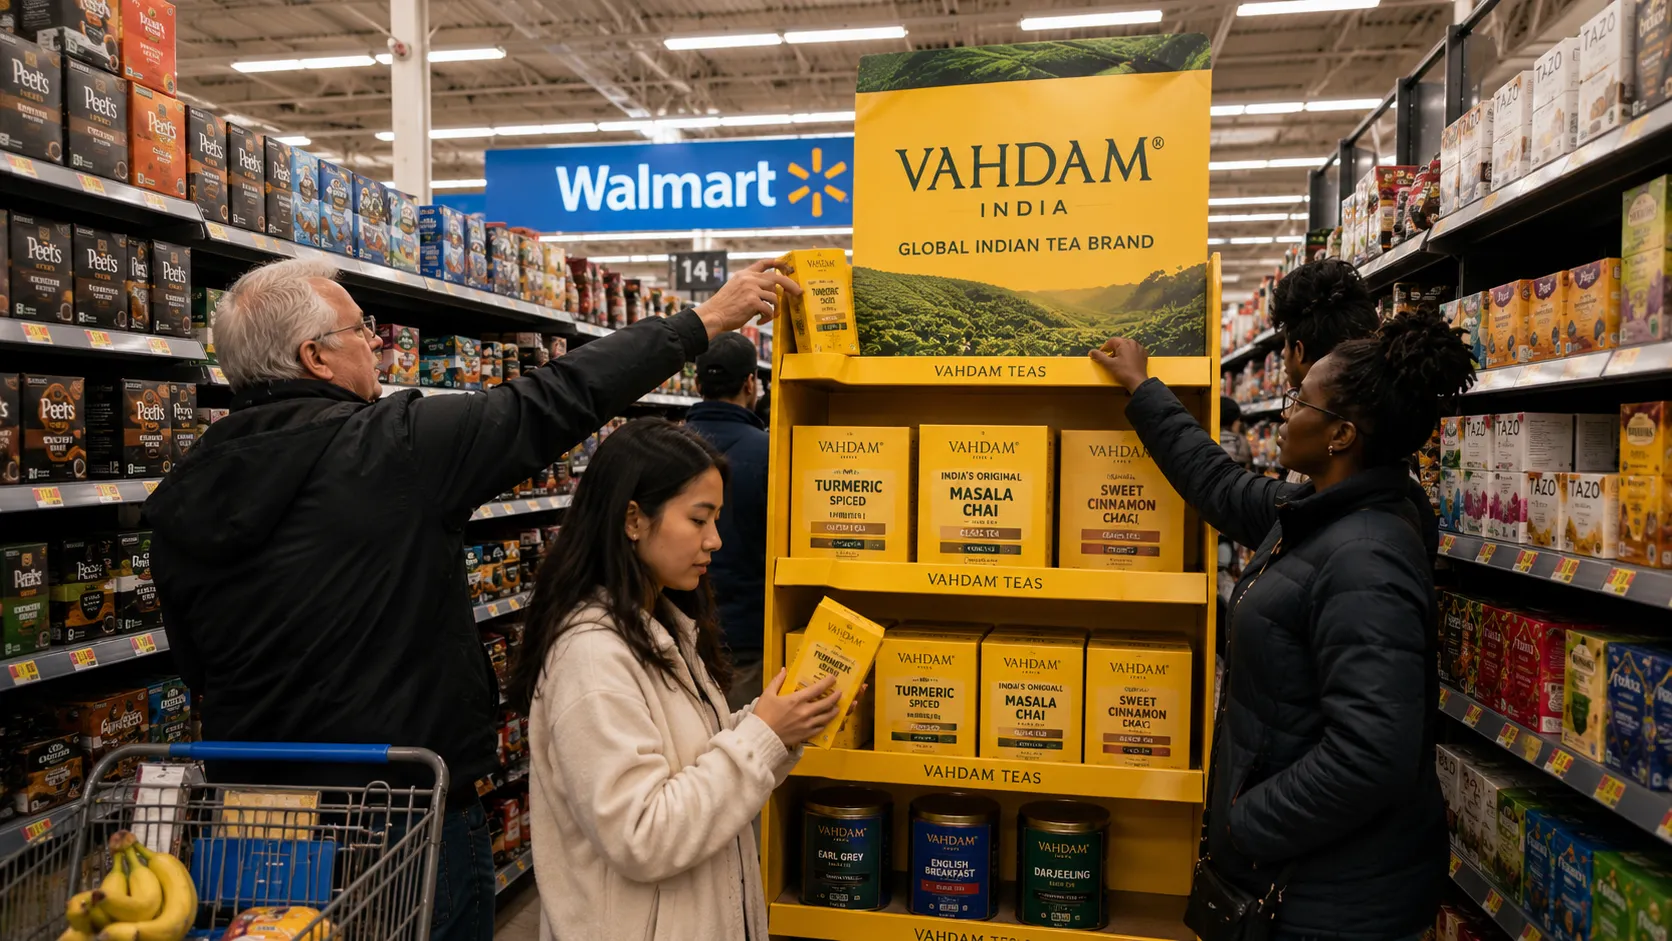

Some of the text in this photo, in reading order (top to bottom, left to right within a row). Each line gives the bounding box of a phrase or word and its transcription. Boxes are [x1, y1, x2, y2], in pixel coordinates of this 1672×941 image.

[1583, 12, 1616, 51] TAZO
[555, 160, 776, 212] Walmart
[981, 199, 1068, 218] INDIA
[898, 234, 1154, 256] GLOBAL INDIAN TEA BRAND
[682, 260, 708, 283] 14
[934, 365, 1047, 378] VAHDAM TEAS
[1495, 419, 1520, 436] TAZO
[815, 479, 883, 493] TURMERIC
[1101, 484, 1144, 497] SWEET
[1529, 478, 1556, 496] TAZO
[1569, 480, 1600, 499] TAZO
[829, 495, 866, 506] SPICED
[949, 486, 1013, 501] MASALA
[963, 504, 998, 517] CHAI
[1087, 498, 1156, 511] CINNAMON
[928, 573, 1043, 590] VAHDAM TEAS
[895, 684, 954, 699] TURMERIC
[909, 699, 940, 709] SPICED
[1005, 695, 1057, 708] MASALA
[1119, 695, 1157, 707] SWEET
[1016, 709, 1045, 721] CHAI
[1108, 706, 1167, 720] CINNAMON
[923, 764, 1042, 785] VAHDAM TEAS
[818, 850, 864, 862] EARL GREY
[931, 858, 969, 869] ENGLISH
[925, 866, 976, 878] BREAKFAST
[1034, 867, 1091, 880] DARJEELING
